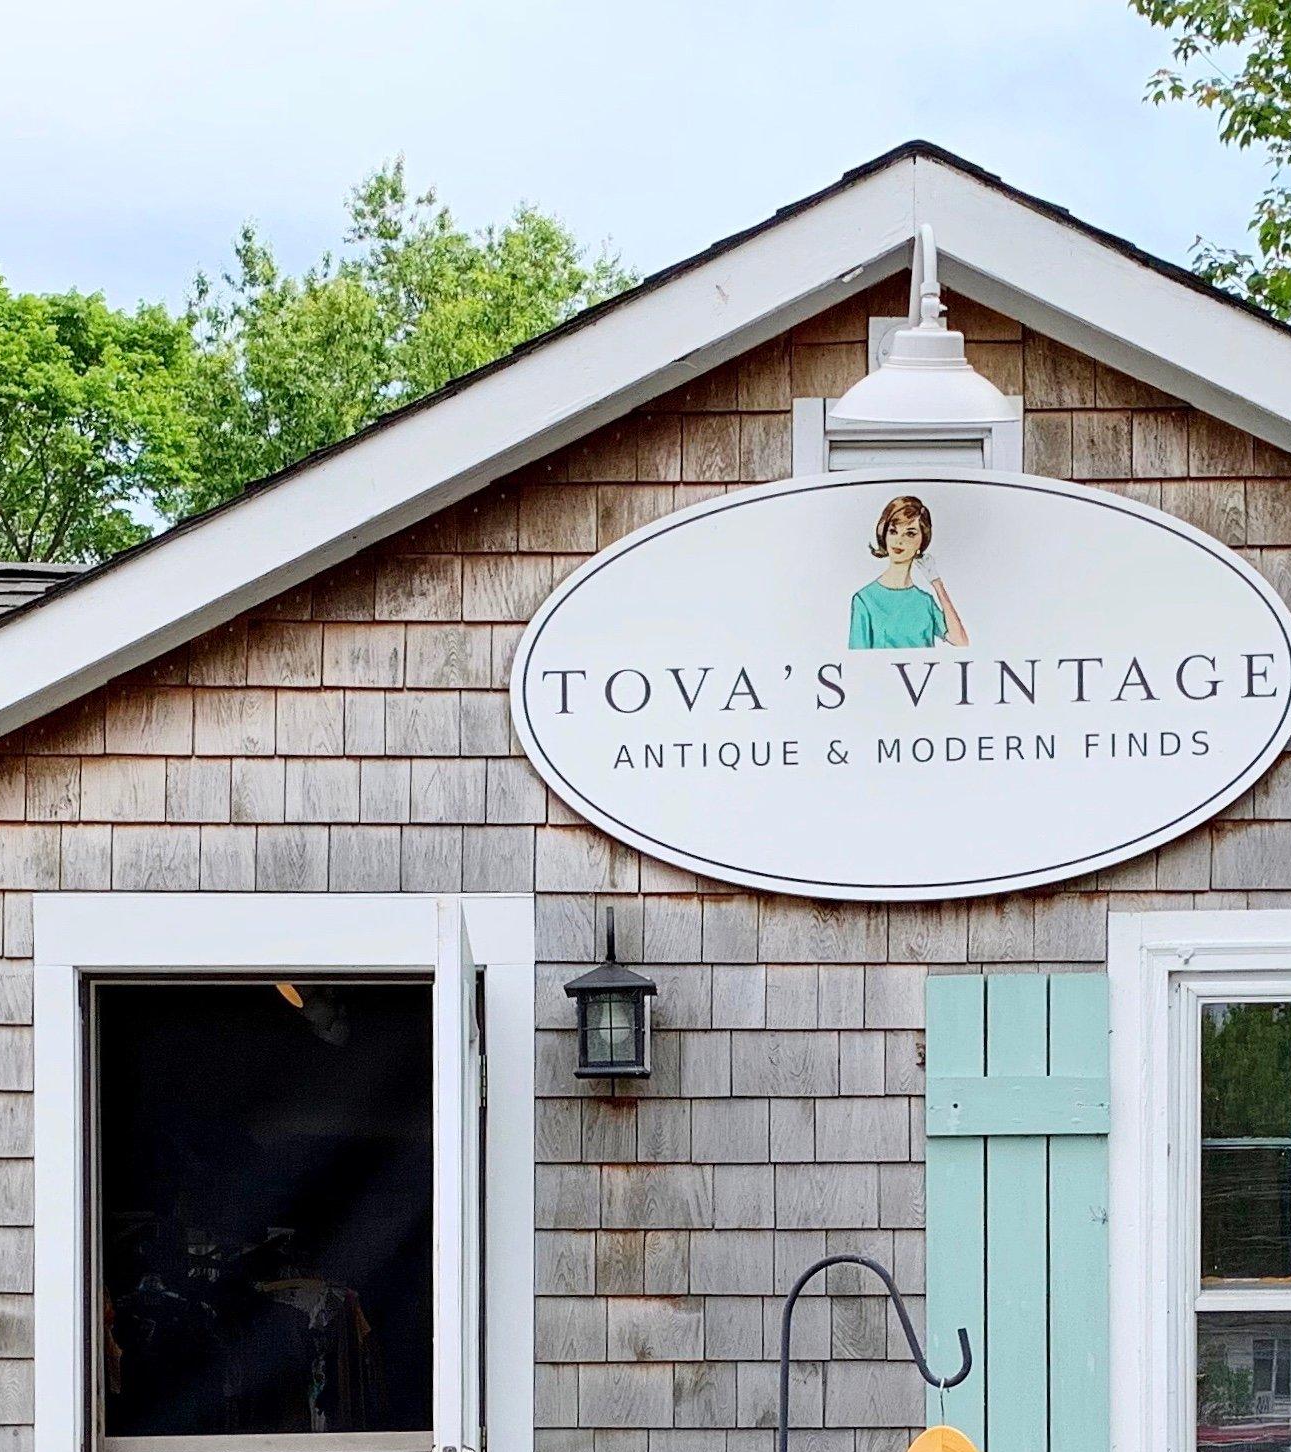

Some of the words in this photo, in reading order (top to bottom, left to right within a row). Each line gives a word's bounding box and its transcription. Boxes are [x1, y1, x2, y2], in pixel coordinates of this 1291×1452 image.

[542, 662, 847, 715] TOVA'S
[891, 653, 1278, 708] VINTAGE
[613, 740, 800, 771] ANTIQUE
[827, 739, 849, 765] &
[877, 734, 1056, 764] MODERN
[1085, 730, 1211, 759] FINDS
